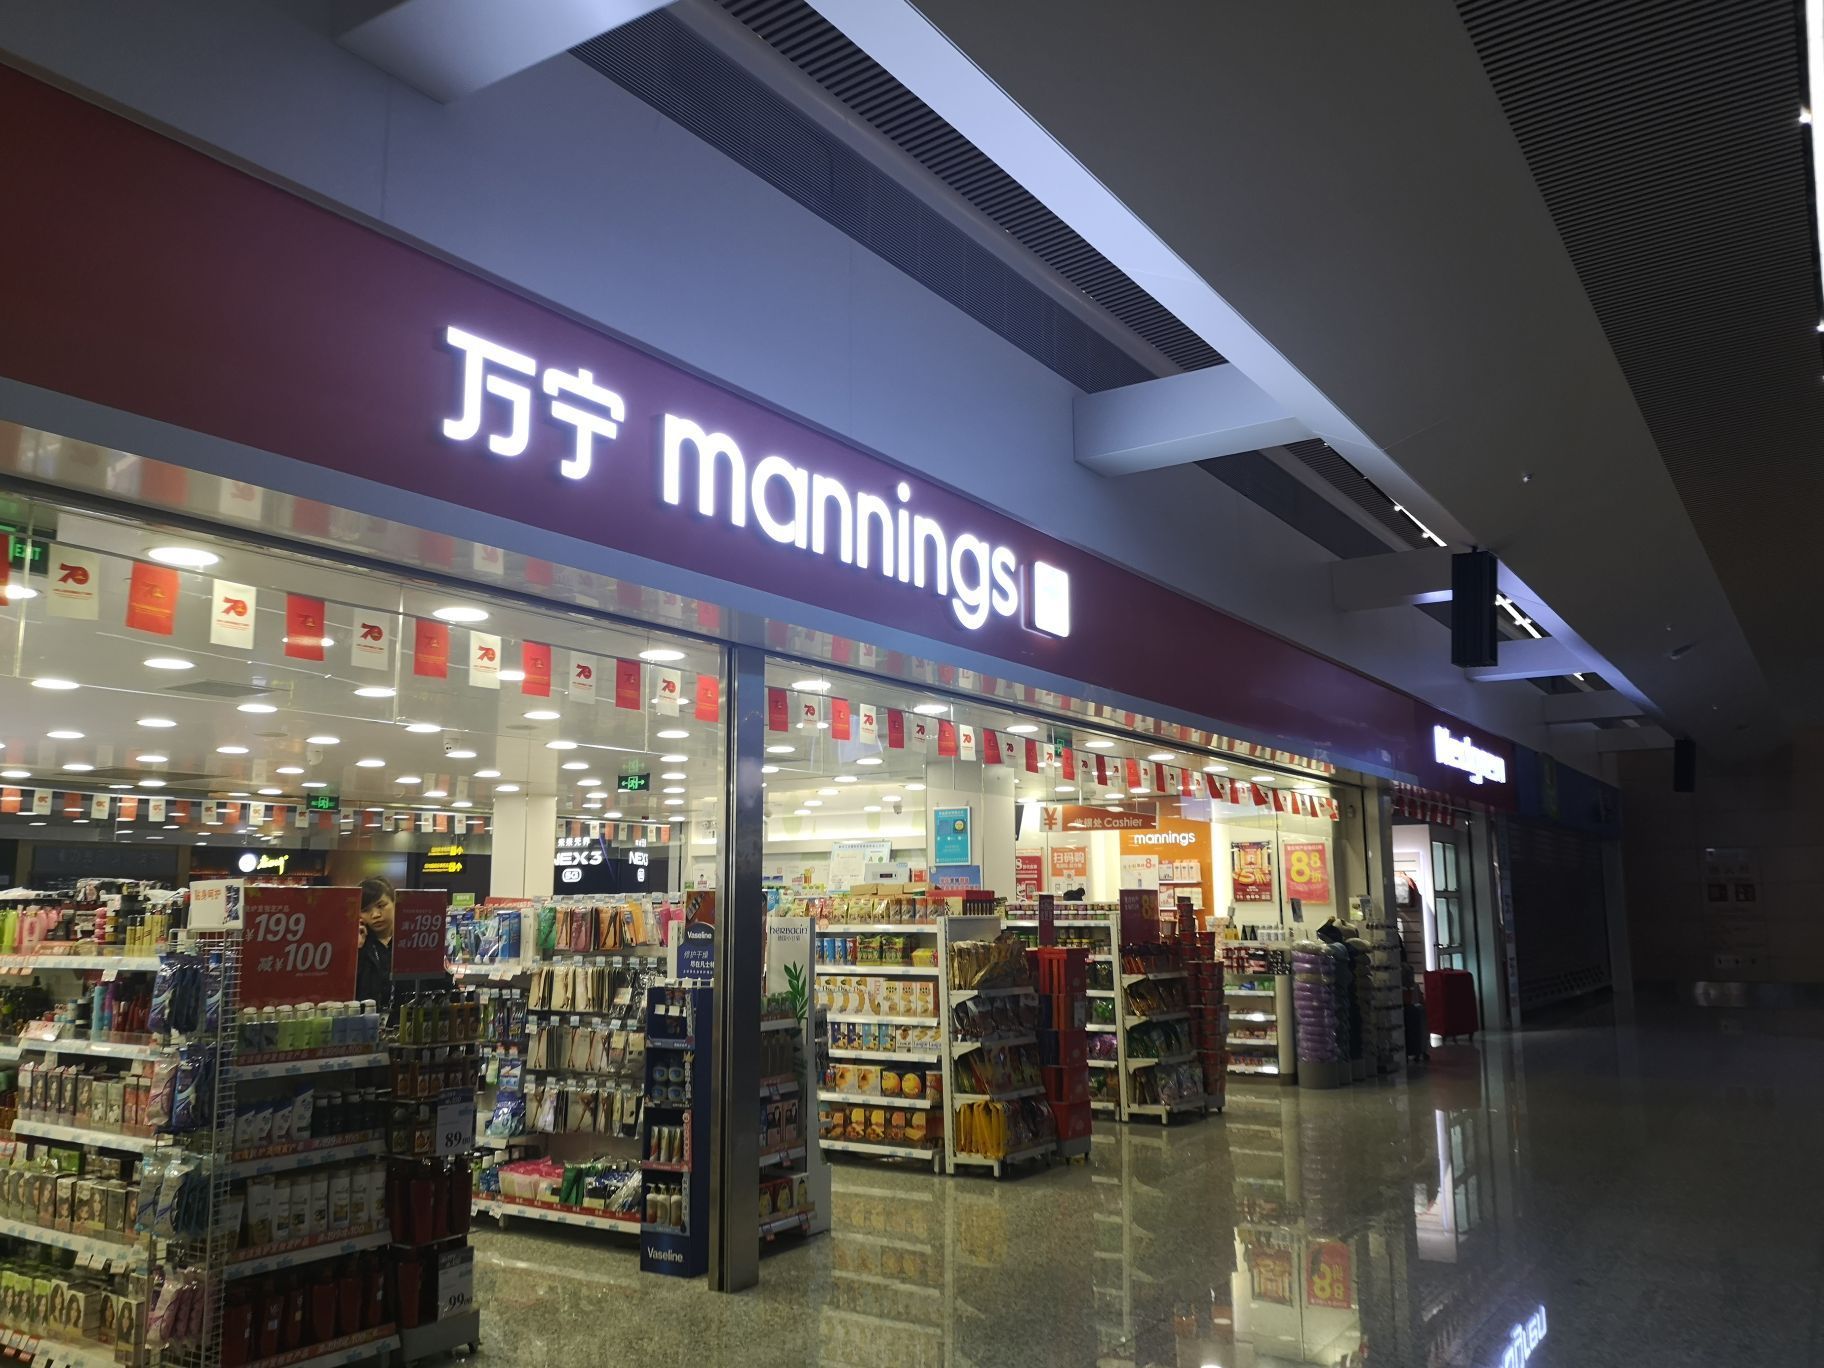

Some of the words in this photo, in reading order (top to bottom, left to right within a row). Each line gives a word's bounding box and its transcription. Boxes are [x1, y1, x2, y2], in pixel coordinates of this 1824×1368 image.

[443, 326, 625, 480] 万宁
[663, 413, 1019, 629] mannings
[361, 622, 383, 641] 70
[1103, 817, 1143, 828] Cashier
[1133, 831, 1196, 845] mannings
[687, 931, 712, 939] Vaseline
[647, 1246, 683, 1263] Vaseline
